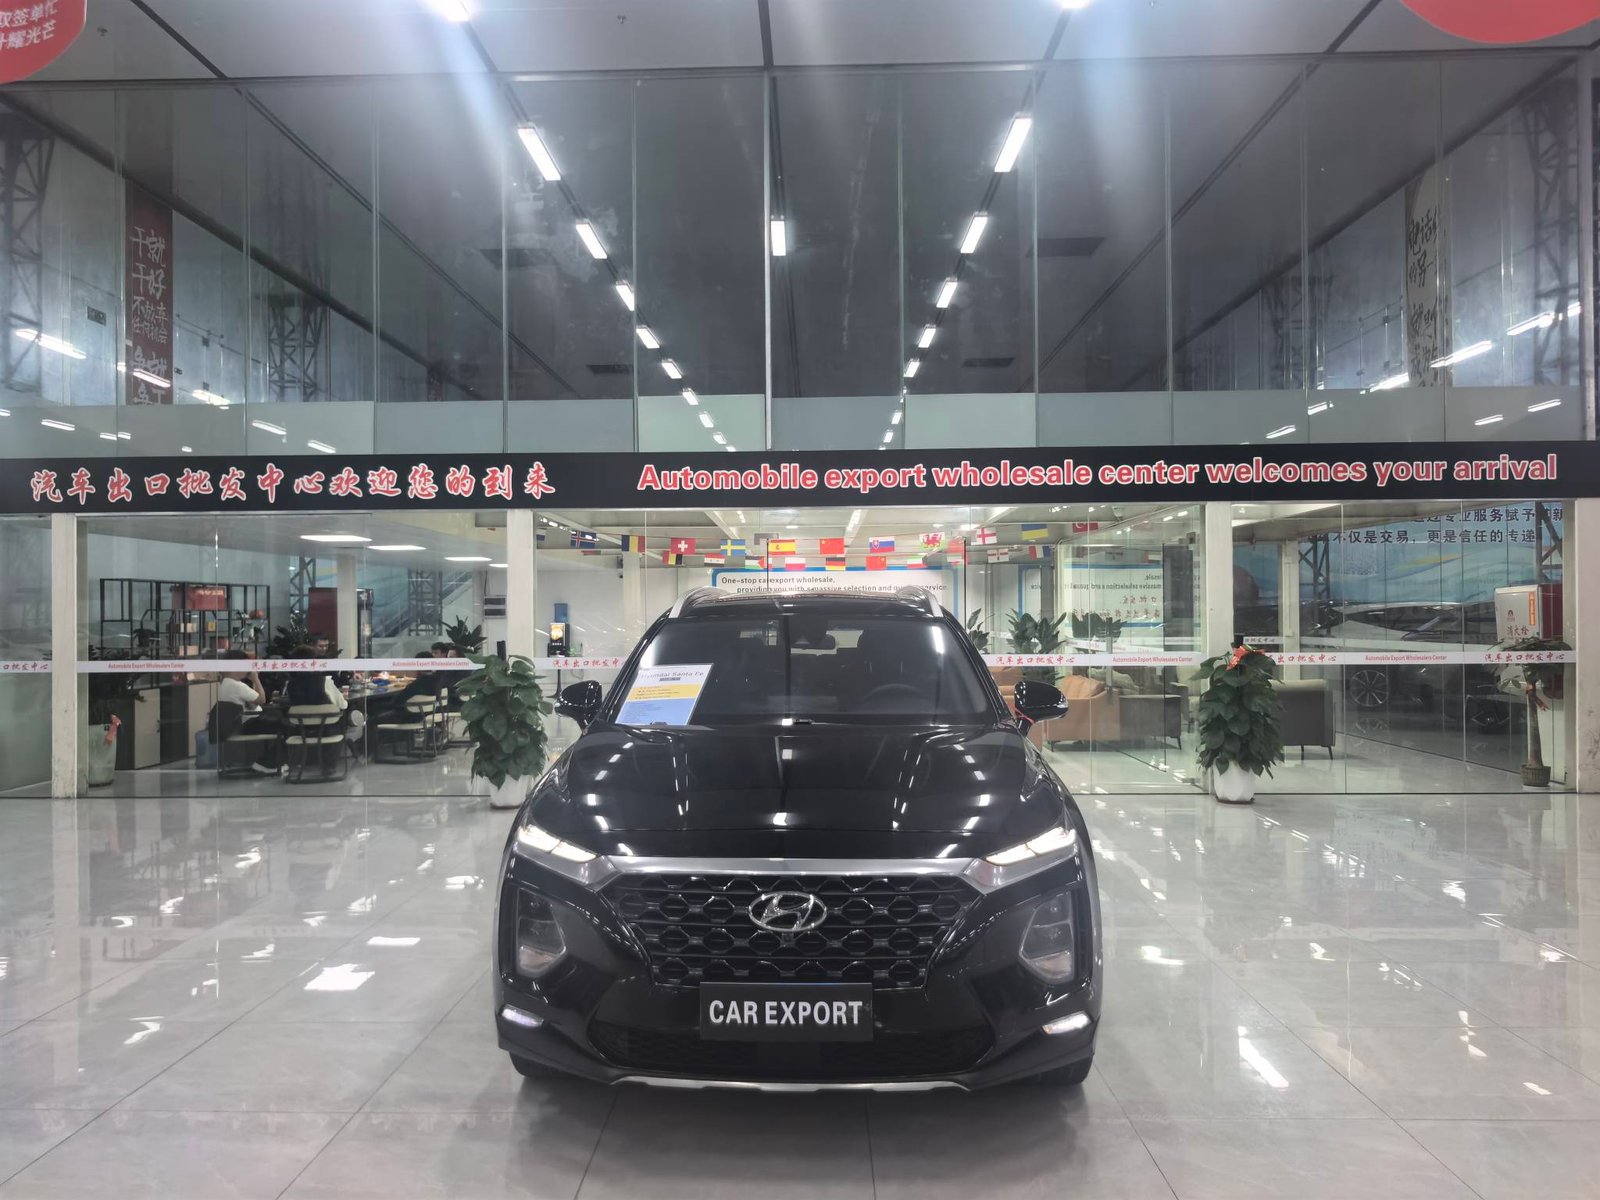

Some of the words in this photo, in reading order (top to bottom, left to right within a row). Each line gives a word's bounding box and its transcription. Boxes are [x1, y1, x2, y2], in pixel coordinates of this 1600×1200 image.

[637, 464, 818, 490] Automobile
[824, 464, 926, 493] export
[932, 459, 1093, 486] wholesale
[1098, 460, 1200, 485] center
[1204, 457, 1368, 483] welcomes
[1372, 461, 1447, 487] your
[1453, 453, 1558, 480] arrival
[31, 461, 556, 505] 汽车出口批发中心欢迎您的到来
[721, 576, 757, 584] One-stop
[997, 656, 1075, 665] 汽车出口批发中心
[1268, 654, 1336, 664] 出口批发中心
[1365, 655, 1390, 663] Automobile
[1391, 655, 1405, 663] Export
[1485, 652, 1565, 662] 汽车出口批发中心
[252, 661, 327, 670] 汽车出口批发中心
[709, 1000, 758, 1024] CAR
[765, 1001, 863, 1024] EXPORT
